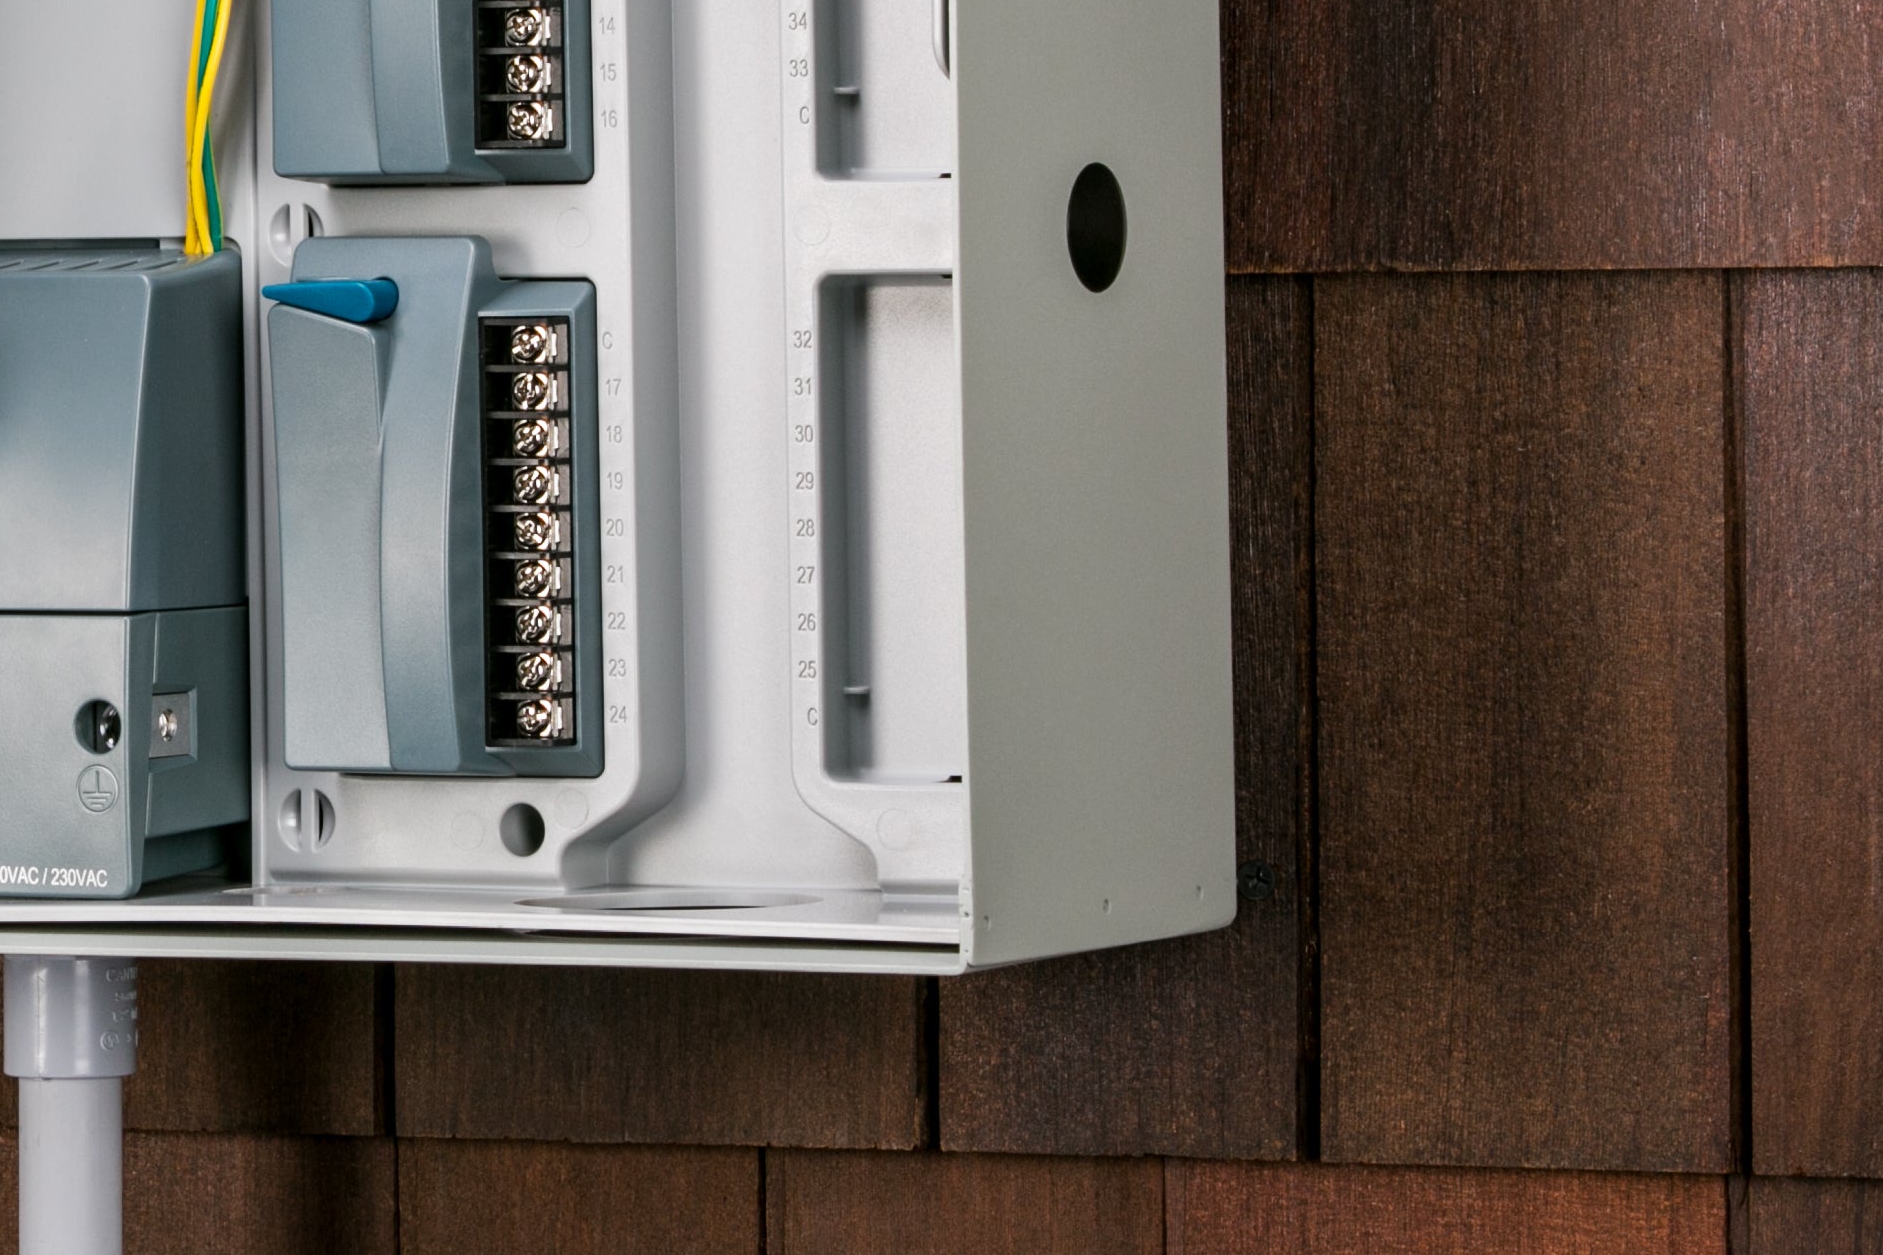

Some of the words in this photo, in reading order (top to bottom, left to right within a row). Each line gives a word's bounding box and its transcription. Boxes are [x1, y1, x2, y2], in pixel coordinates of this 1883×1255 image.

[788, 12, 809, 31] 34
[600, 63, 617, 82] 15
[789, 59, 809, 78] 33
[793, 330, 813, 349] 32
[794, 378, 813, 397] 31
[606, 425, 622, 444] 18
[795, 425, 814, 444] 30
[796, 472, 815, 491] 29
[606, 519, 624, 538] 20
[796, 519, 816, 538] 28
[607, 565, 624, 584] 21
[797, 566, 817, 585] 27
[607, 612, 626, 631] 22
[798, 613, 817, 632] 26
[608, 659, 627, 678] 23
[798, 661, 817, 679] 25
[609, 706, 628, 724] 24
[51, 867, 108, 888] 230VAC
